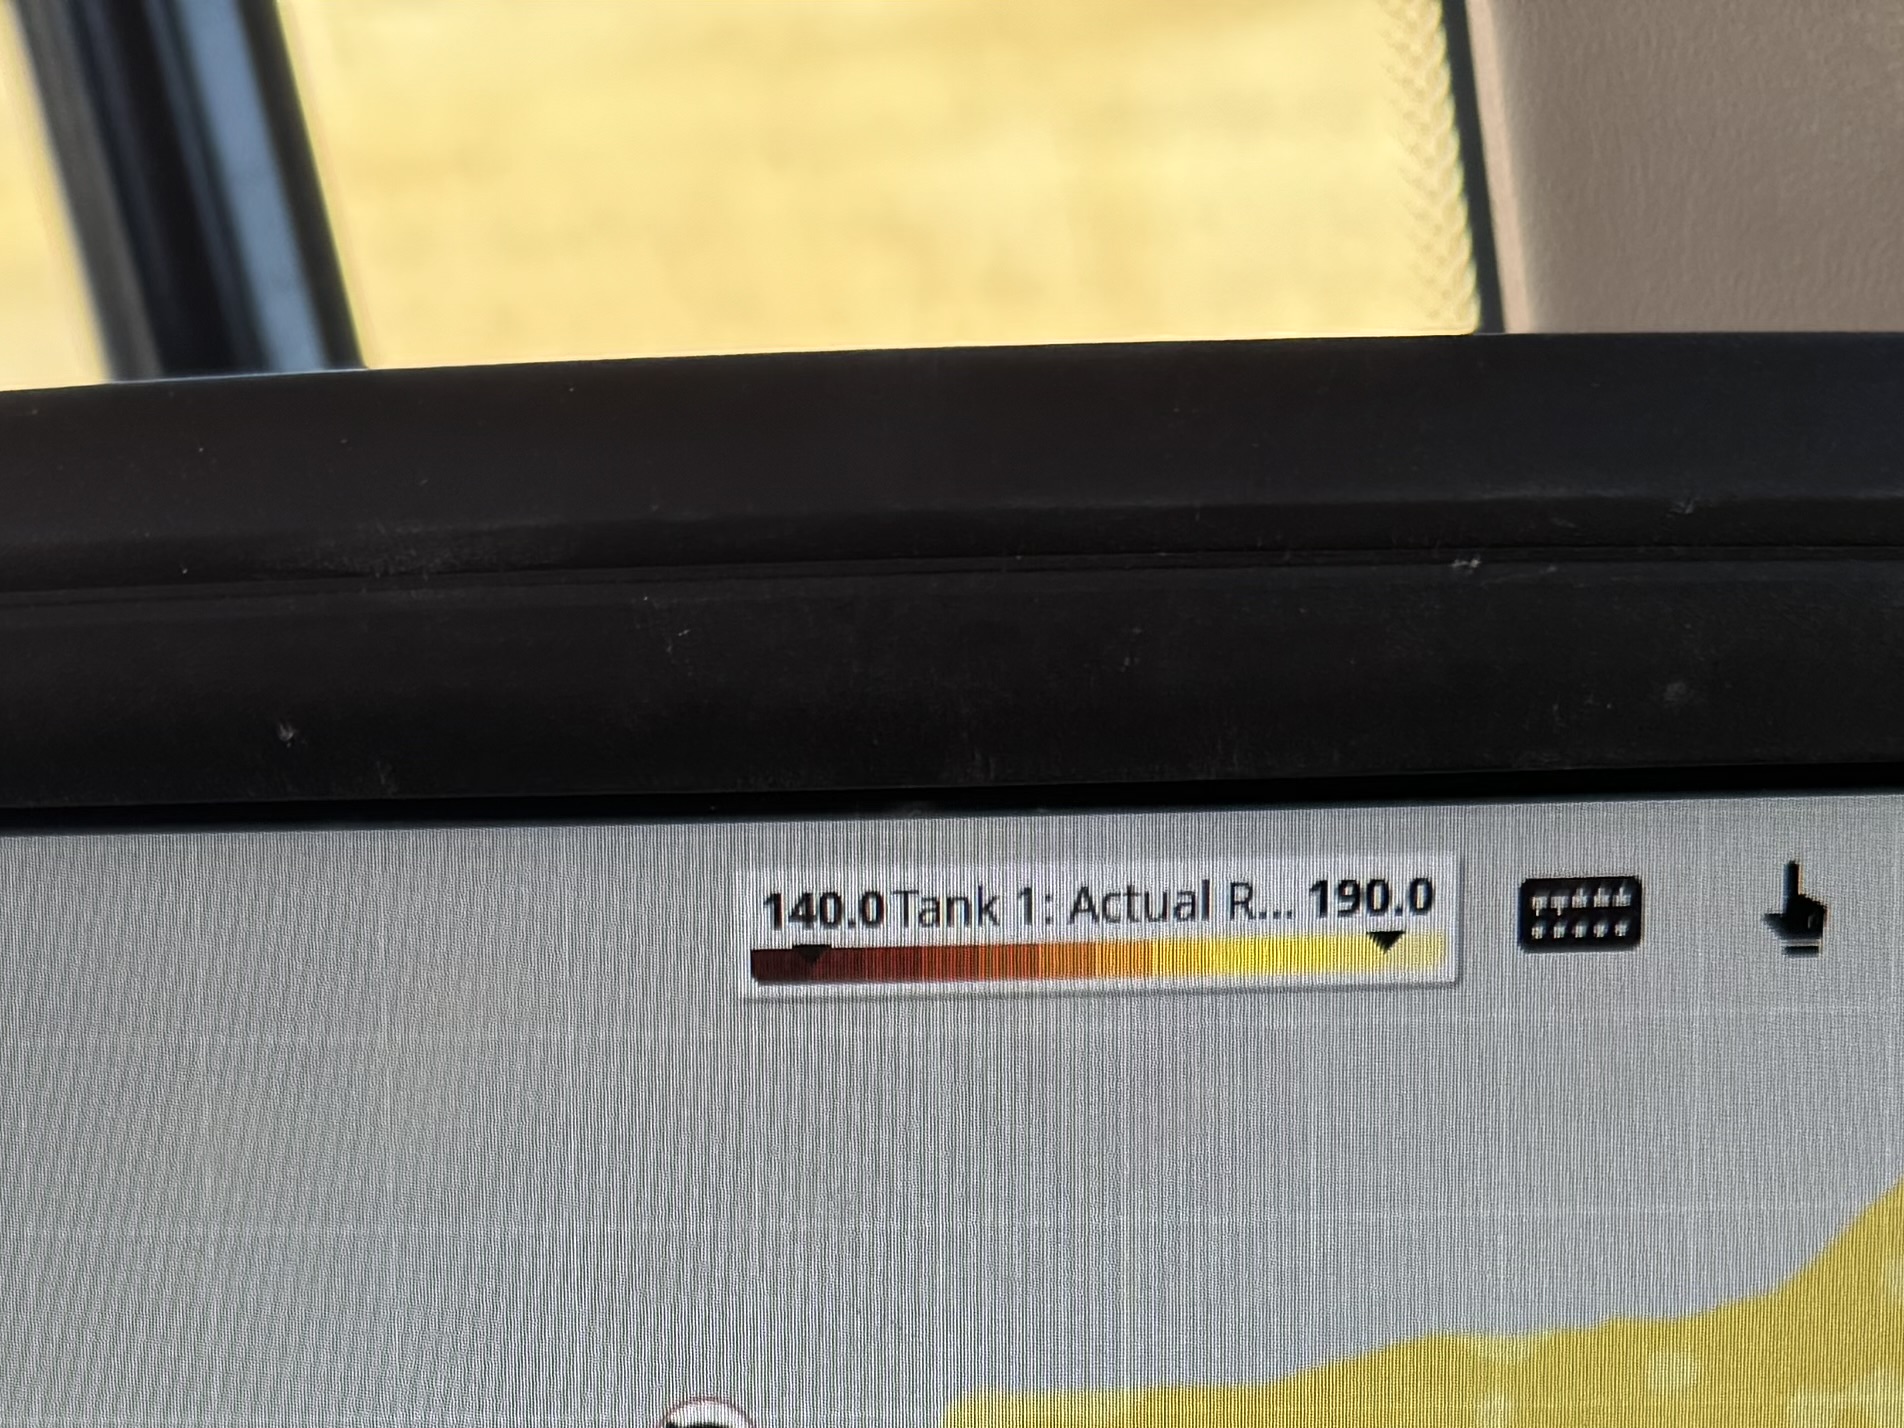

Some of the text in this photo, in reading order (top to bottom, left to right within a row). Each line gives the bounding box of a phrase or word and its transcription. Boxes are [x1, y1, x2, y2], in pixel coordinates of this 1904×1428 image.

[763, 878, 1434, 931] 140.0 Tank 1: Actual R... 190.0
